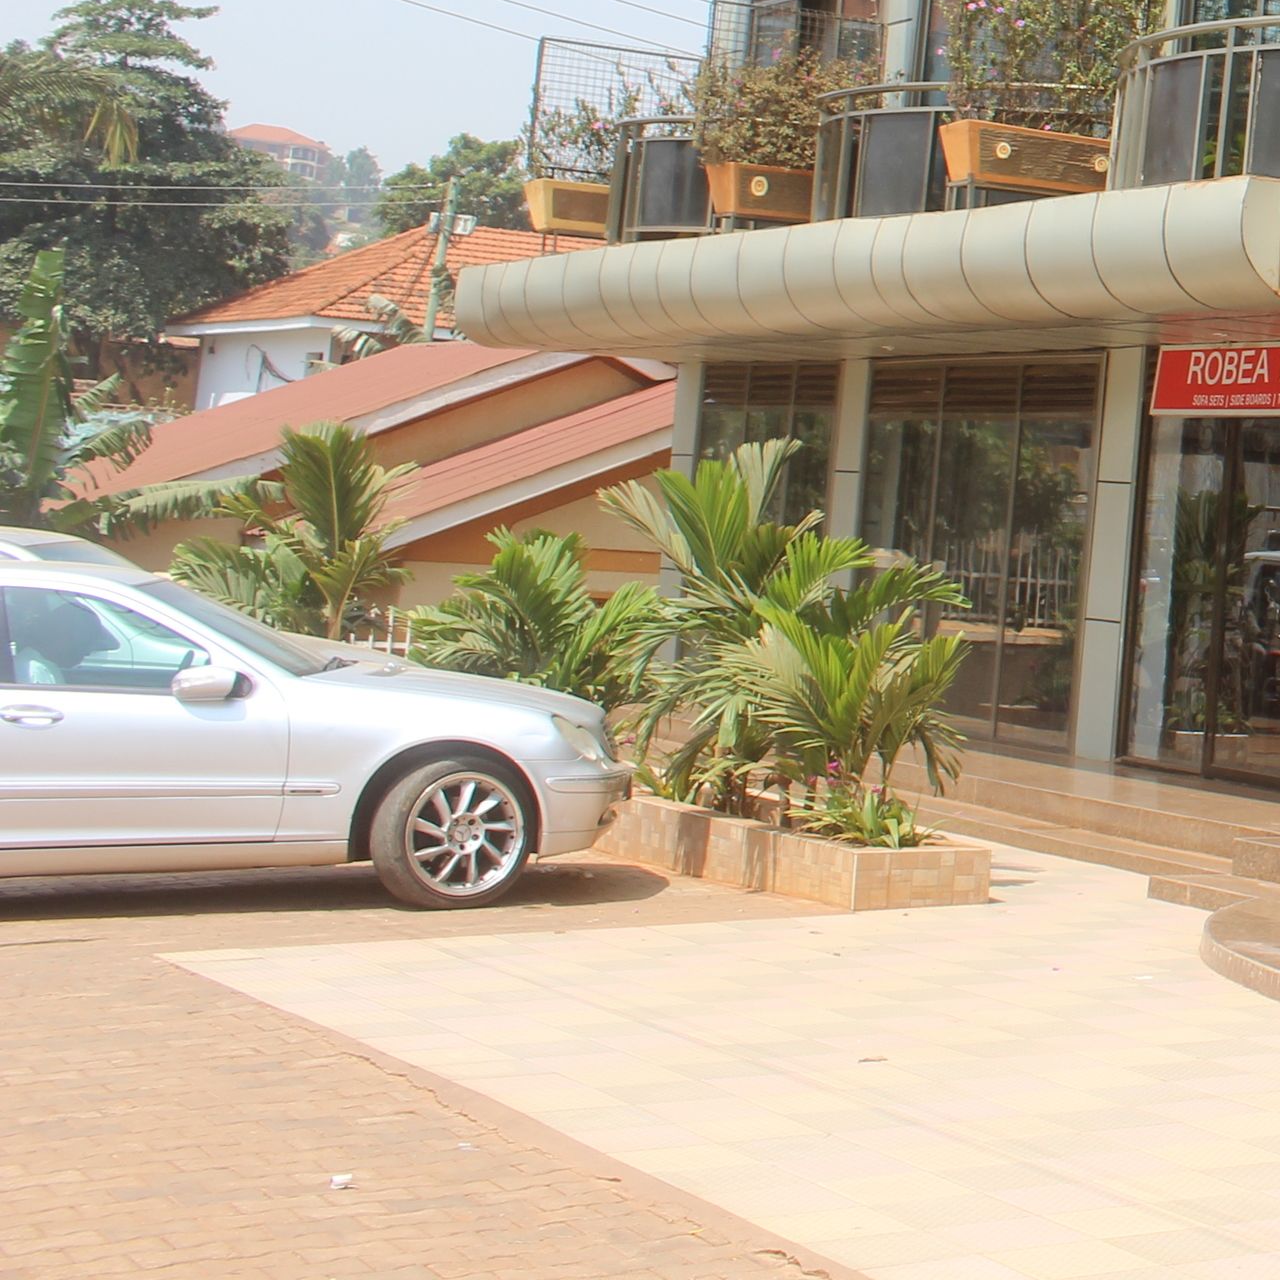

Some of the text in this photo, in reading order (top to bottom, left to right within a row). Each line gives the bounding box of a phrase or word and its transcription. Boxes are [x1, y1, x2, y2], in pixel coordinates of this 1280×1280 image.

[1186, 348, 1269, 385] ROBEA
[1192, 394, 1208, 406] SOFA
[1209, 395, 1225, 406] SETS
[1229, 394, 1245, 406] SIDE
[1245, 393, 1272, 405] BOARDS
